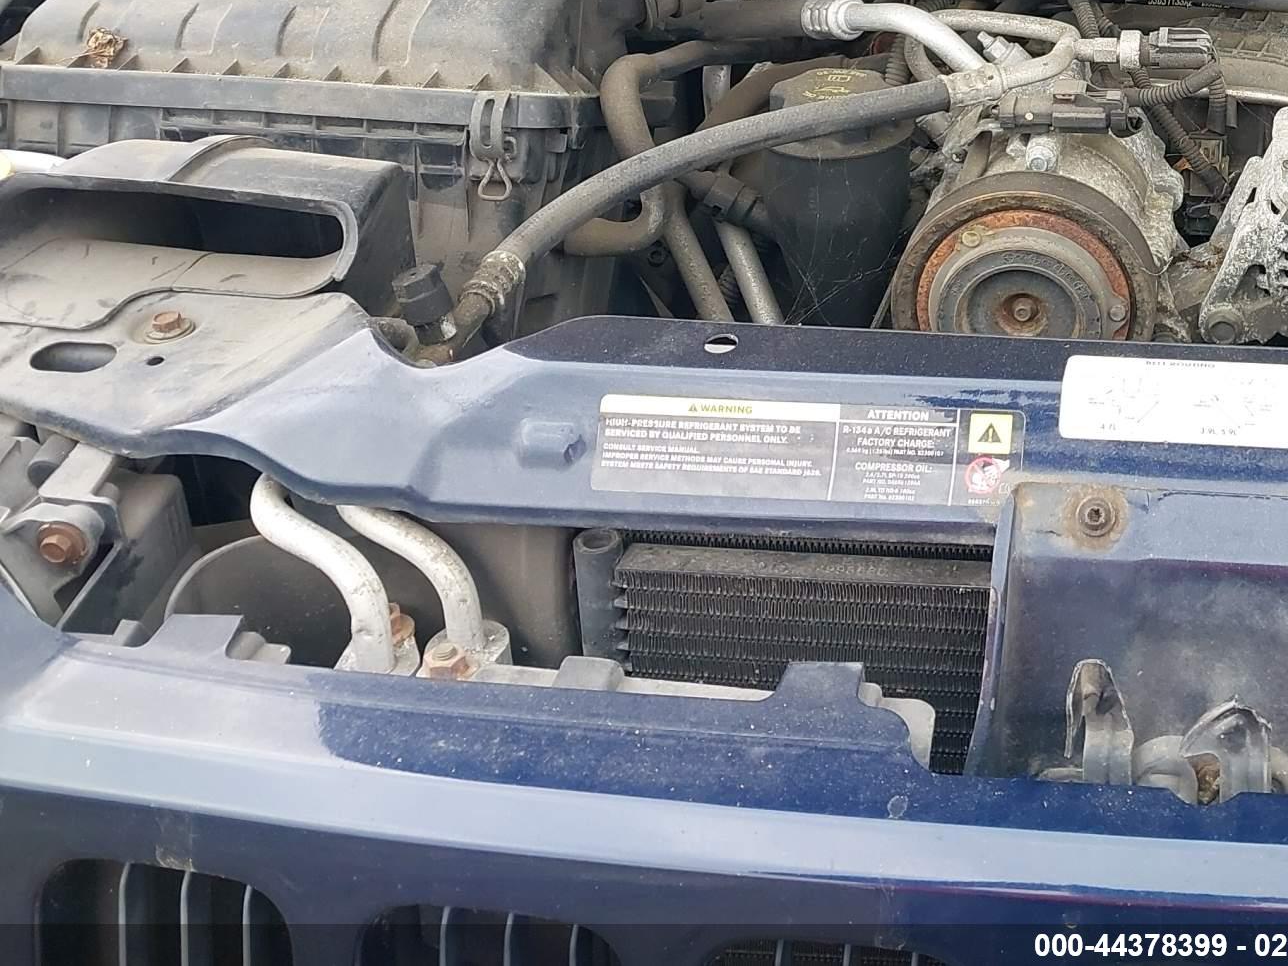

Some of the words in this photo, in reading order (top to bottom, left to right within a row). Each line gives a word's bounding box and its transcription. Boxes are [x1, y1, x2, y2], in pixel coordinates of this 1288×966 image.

[701, 404, 753, 415] WARNING
[866, 409, 930, 422] ATTENTION
[677, 420, 739, 432] REFRIGERANT
[739, 423, 775, 434] SYSTEM
[775, 425, 787, 434] TO
[788, 425, 802, 435] BE
[842, 424, 873, 435] R-134a
[873, 426, 893, 437] A/C
[893, 427, 952, 438] REFRIGERANT
[604, 428, 648, 439] SERVICED
[648, 429, 661, 440] BY
[661, 430, 708, 442] QUALIFIED
[709, 432, 762, 443] PERSONNEL
[637, 444, 667, 453] SERVICE
[856, 437, 896, 447] FACTORY
[896, 439, 935, 449] CHARGE:
[706, 456, 722, 464] MAY
[855, 461, 914, 473] COMPRESSOR
[915, 463, 933, 474] OIL:
